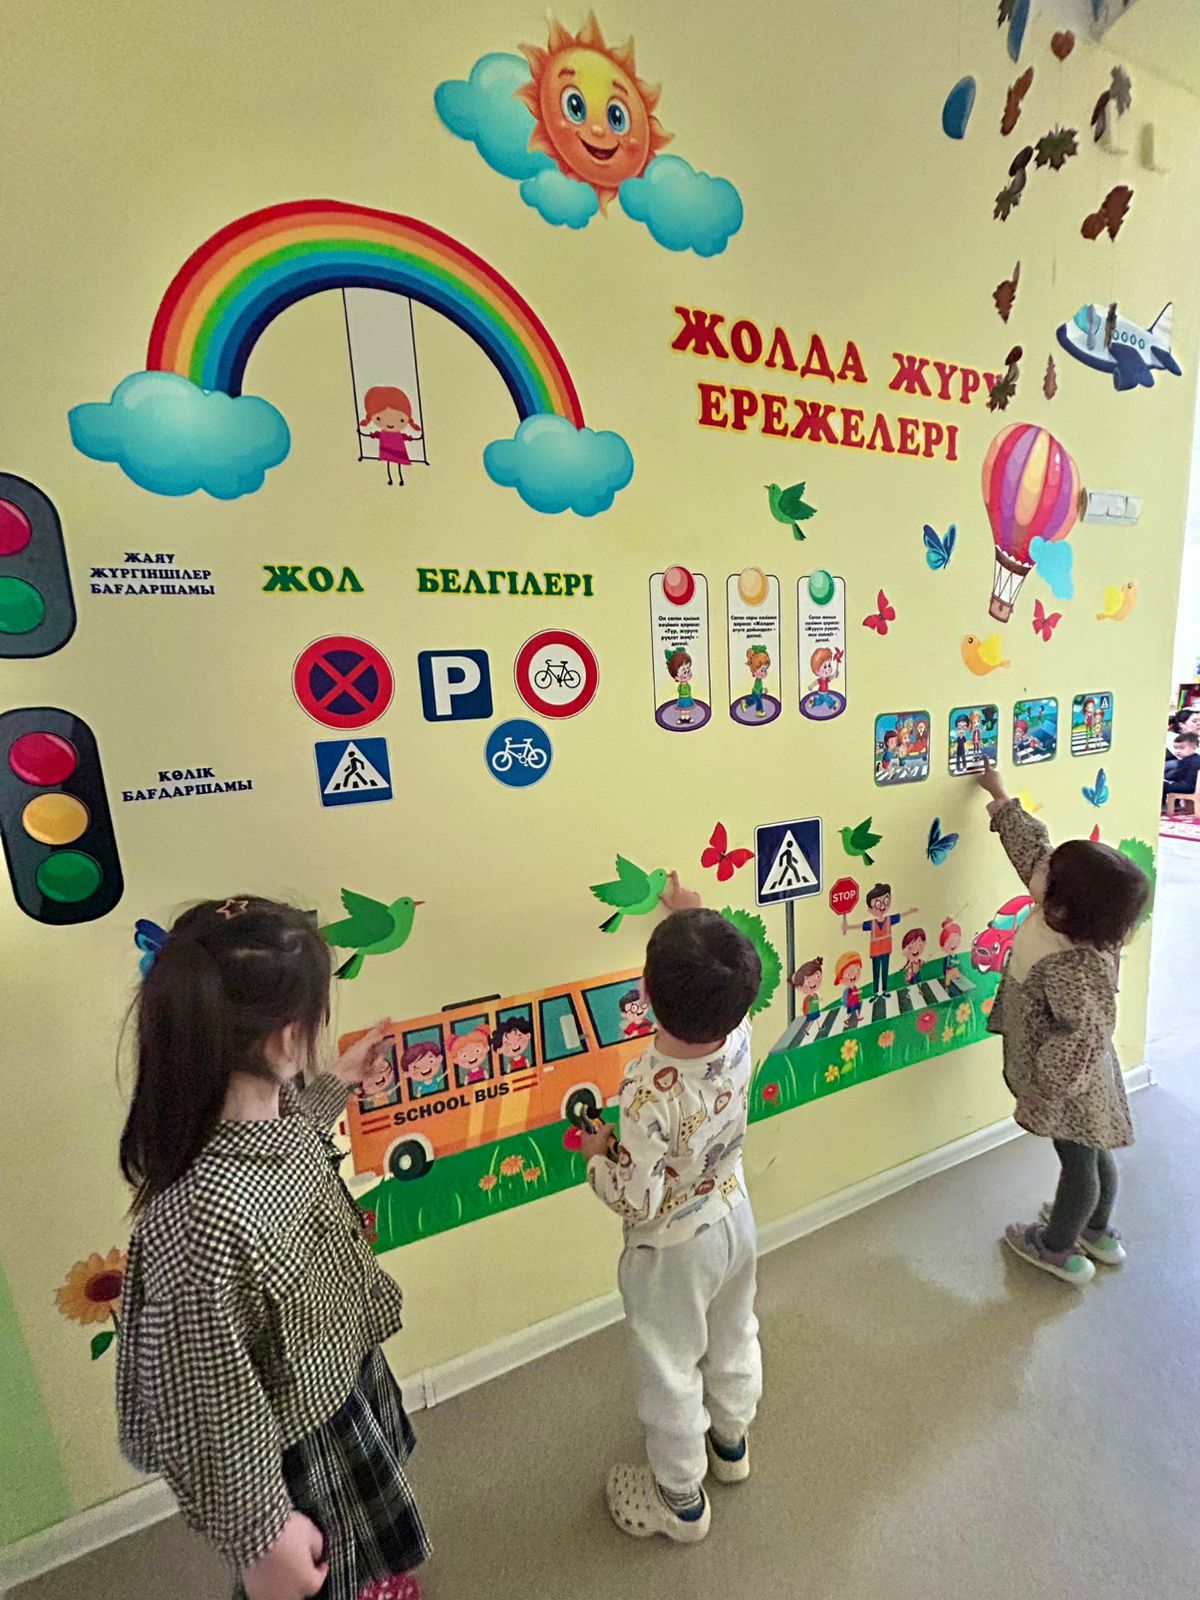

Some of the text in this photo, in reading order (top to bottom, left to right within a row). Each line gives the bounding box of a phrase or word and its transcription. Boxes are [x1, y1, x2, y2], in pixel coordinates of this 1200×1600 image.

[670, 306, 868, 383] ЖОЛДА
[697, 383, 959, 461] ЕРЕЖЕЛЕРІ
[124, 552, 175, 563] ЖАЯУ
[90, 567, 211, 580] ЖҮРГІНШІЛЕР
[262, 565, 594, 597] ЖОЛ БЕЛГІЛЕРІ
[90, 583, 216, 595] БАҒДАРШАМЫ
[430, 655, 482, 717] P
[158, 767, 215, 782] КӨЛІК
[122, 780, 253, 802] БАҒДАРШАМЫ
[832, 889, 856, 903] STOP
[393, 1082, 510, 1125] SCHOOL BUS
